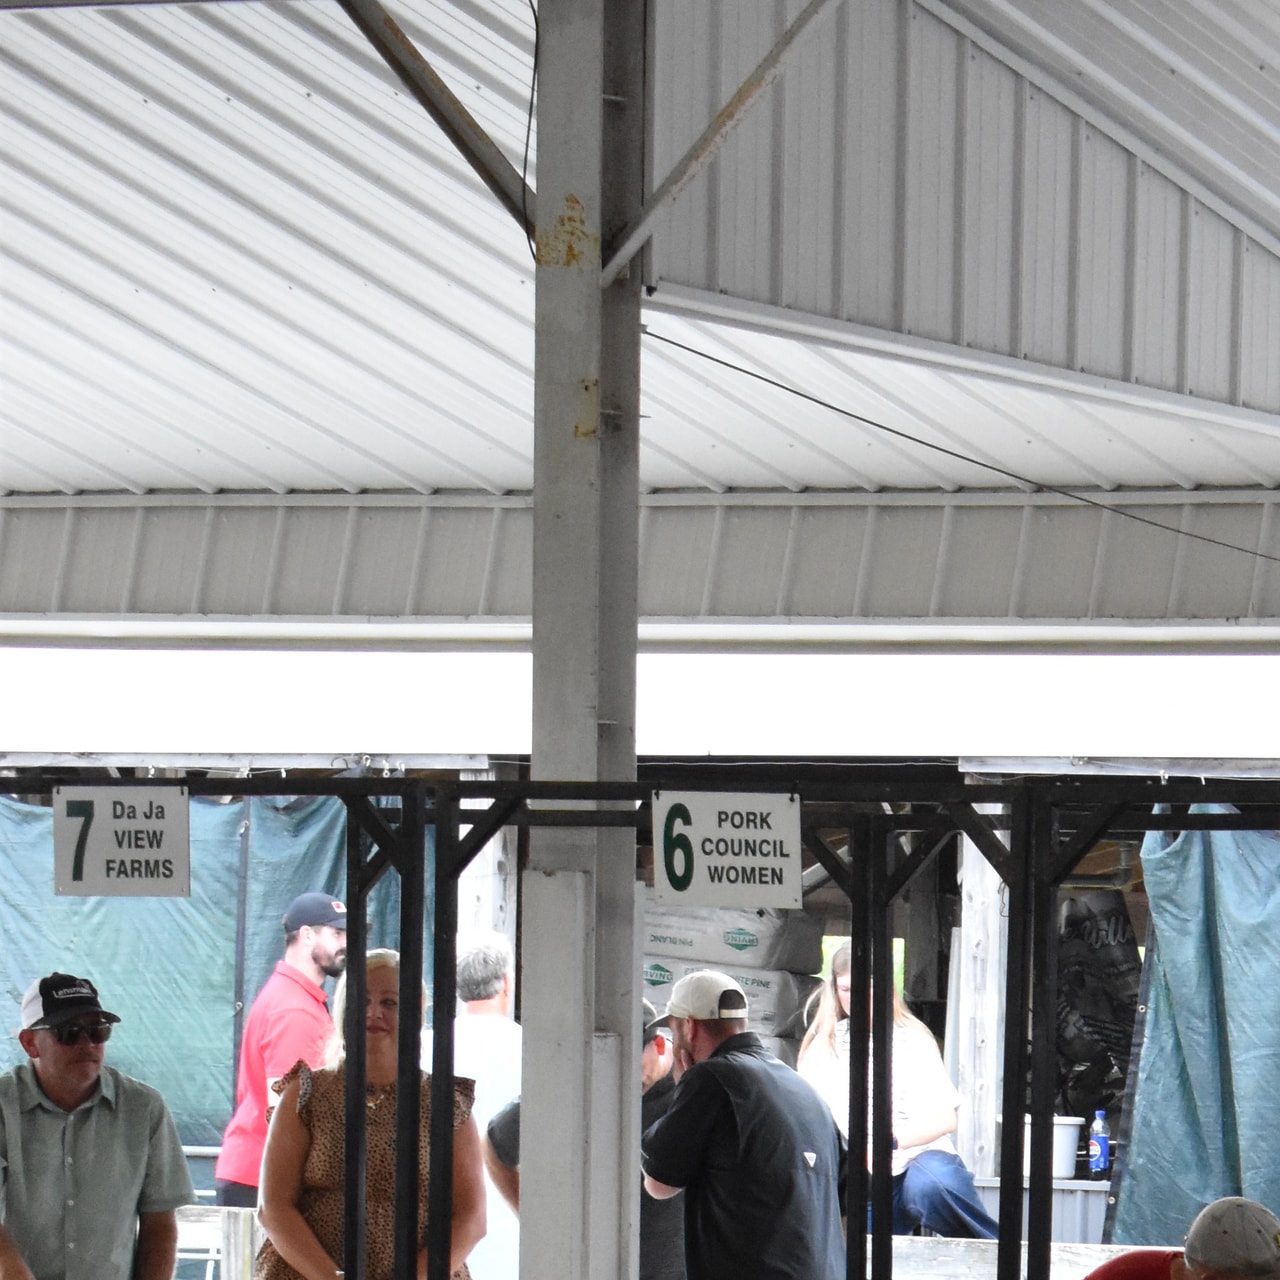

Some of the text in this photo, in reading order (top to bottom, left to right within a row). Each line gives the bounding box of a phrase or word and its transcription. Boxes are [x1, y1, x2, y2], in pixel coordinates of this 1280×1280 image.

[112, 801, 165, 819] Da Ja
[718, 811, 772, 830] PORK
[66, 800, 94, 881] 7
[114, 830, 164, 849] VIEW
[663, 802, 694, 892] 6
[701, 837, 790, 858] COUNCIL
[106, 859, 173, 878] FARMS
[707, 865, 783, 885] WOMEN
[650, 934, 675, 946] BLANC
[644, 971, 673, 981] RVING
[751, 979, 771, 989] PINE
